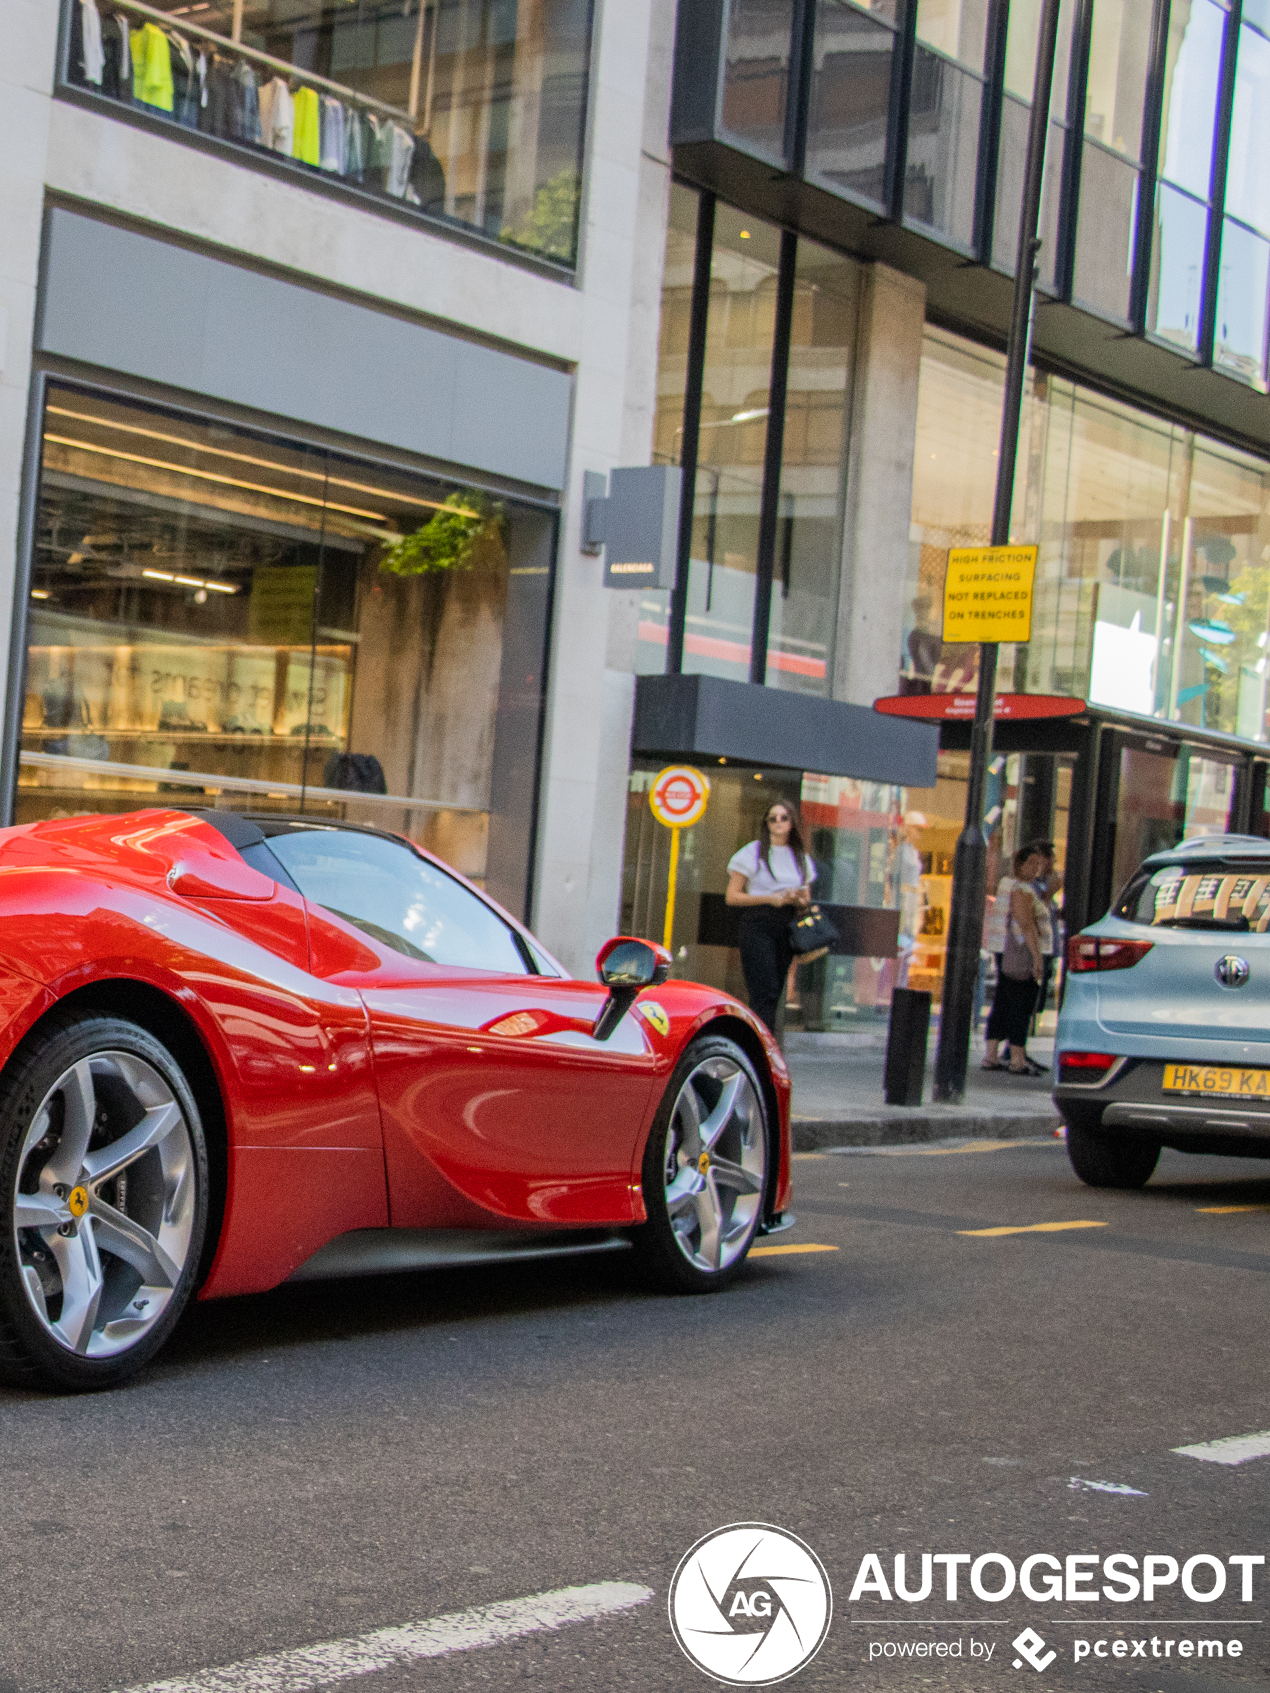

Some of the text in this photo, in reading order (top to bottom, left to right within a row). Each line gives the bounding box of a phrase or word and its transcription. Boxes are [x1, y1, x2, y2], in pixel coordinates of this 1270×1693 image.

[952, 554, 1032, 564] HIGH FRICTION
[959, 573, 1021, 582] SURFACING
[948, 591, 1028, 601] NOT REPLACED
[949, 610, 1025, 620] ON TRENCHES
[1172, 1067, 1233, 1090] HK69
